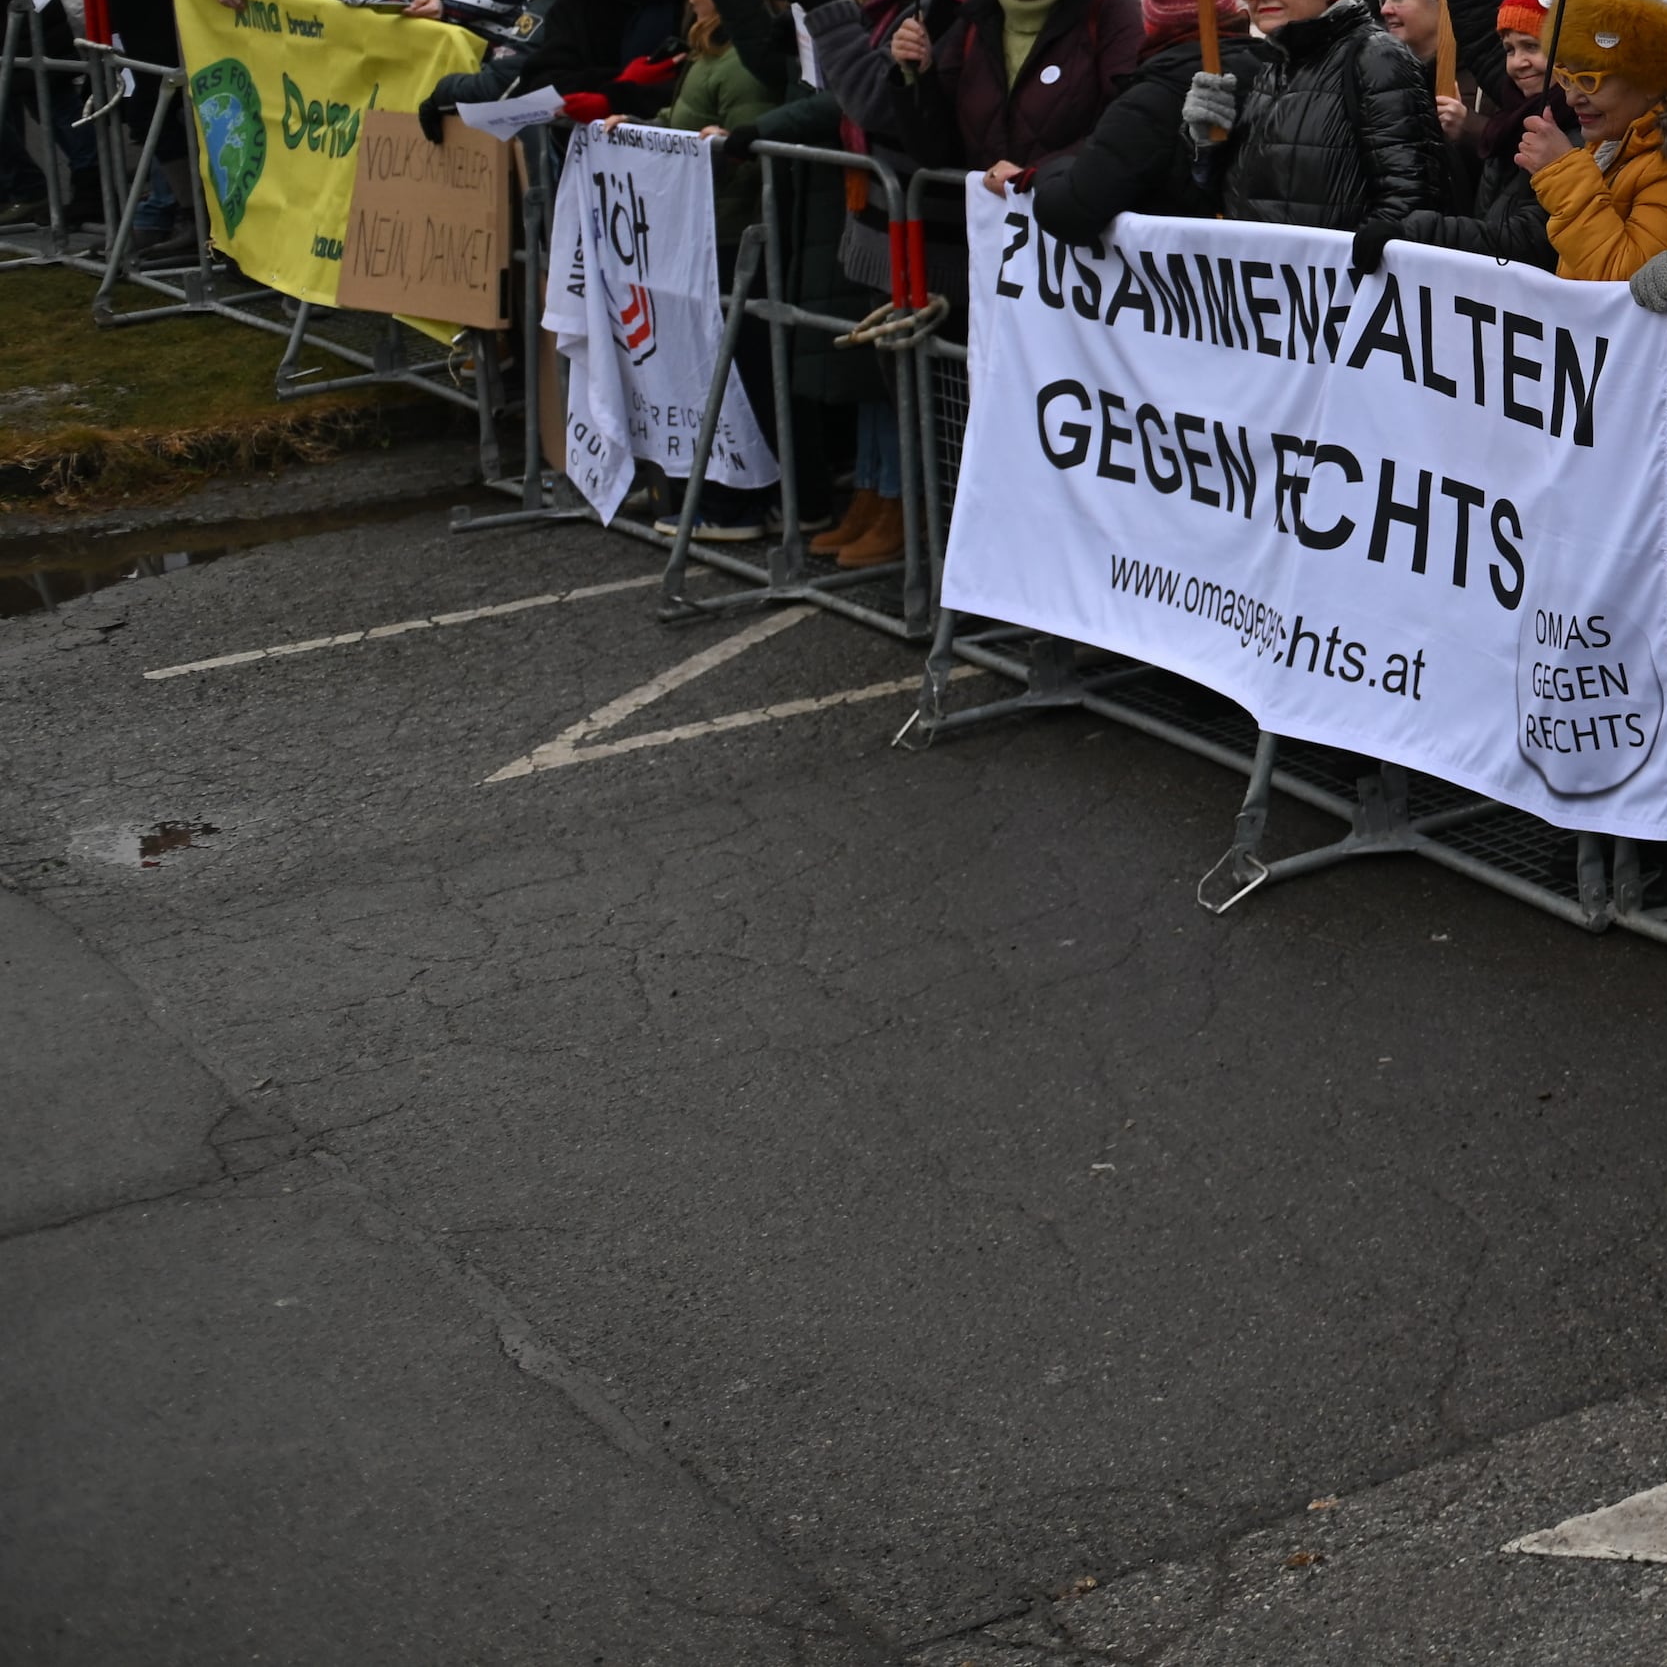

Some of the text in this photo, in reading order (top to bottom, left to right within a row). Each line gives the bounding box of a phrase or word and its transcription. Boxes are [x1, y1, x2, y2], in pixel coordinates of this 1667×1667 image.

[420, 215, 492, 292] DANKE!
[1037, 378, 1257, 520] GEGEN
[1536, 611, 1611, 649] OMAS
[1533, 661, 1630, 705] GEGEN
[1524, 711, 1646, 755] RECHTS
